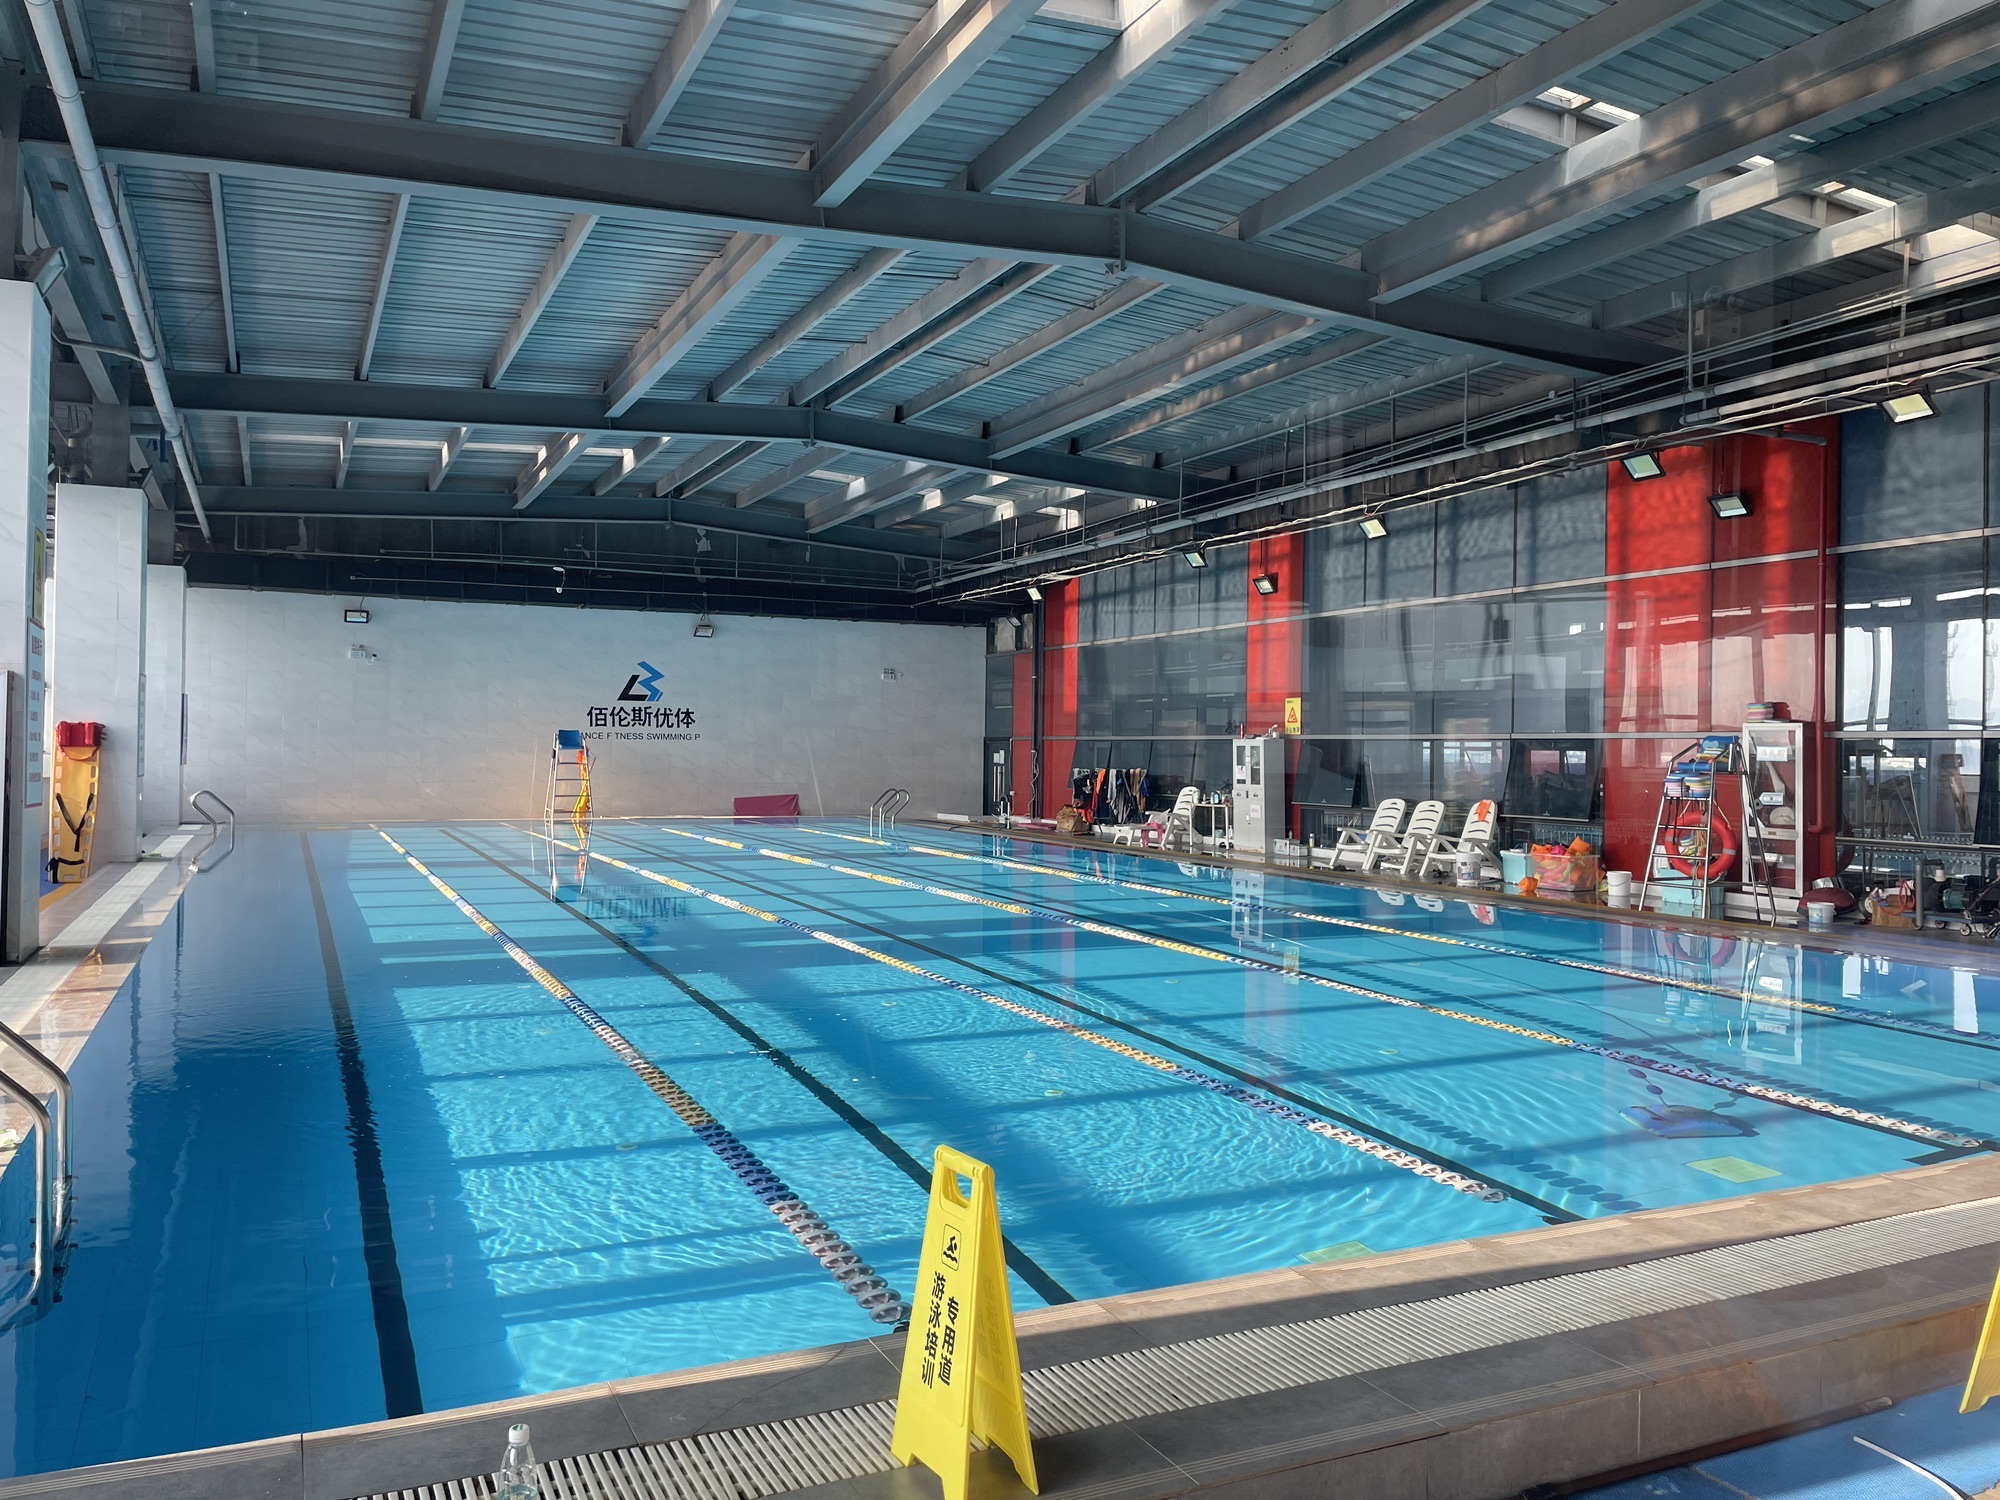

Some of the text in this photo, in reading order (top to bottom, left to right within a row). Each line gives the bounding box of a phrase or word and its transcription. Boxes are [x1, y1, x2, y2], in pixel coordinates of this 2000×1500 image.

[586, 706, 696, 728] 佰伦斯优体
[646, 732, 692, 741] SWIMMING
[921, 1271, 946, 1389] 游泳培训
[938, 1296, 959, 1386] 专用道
